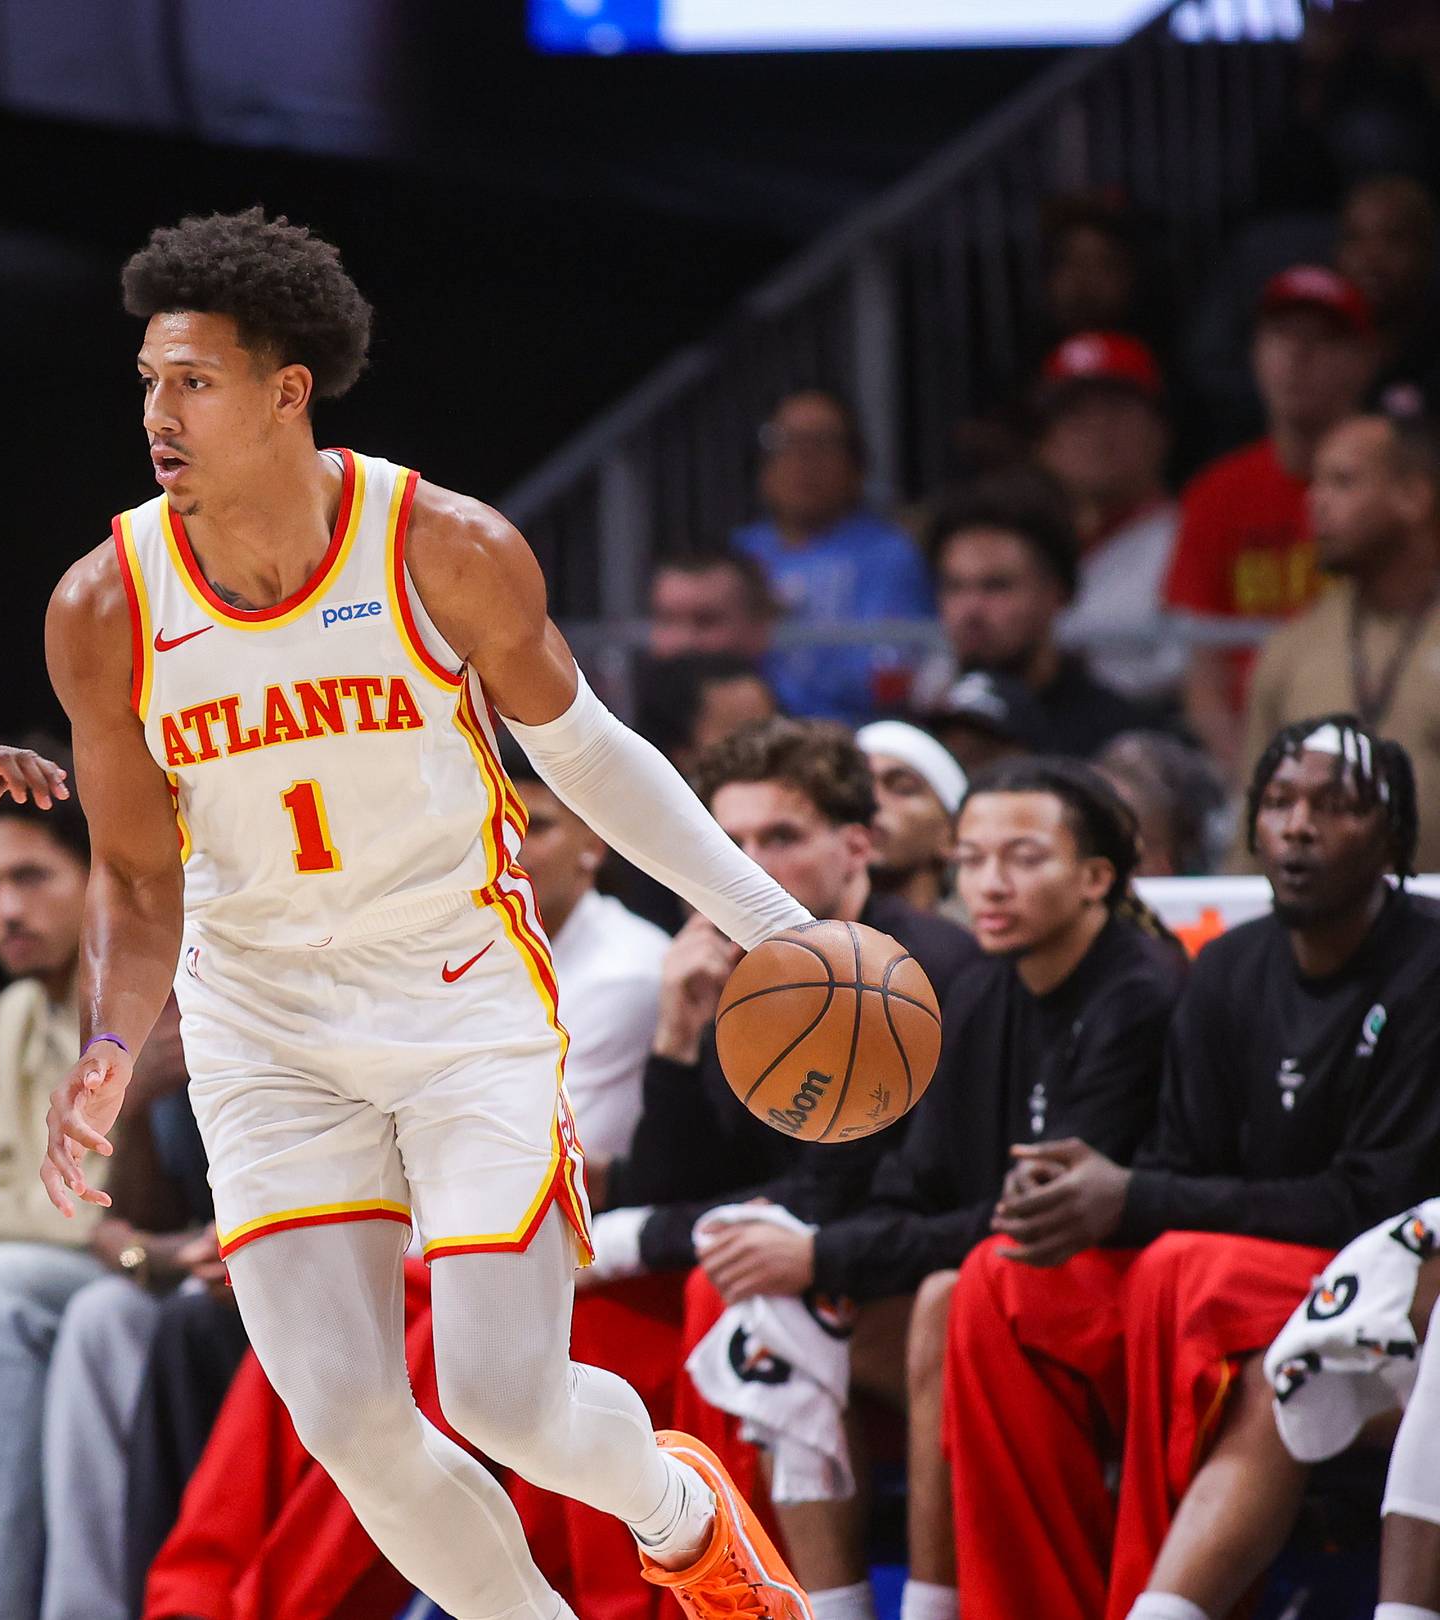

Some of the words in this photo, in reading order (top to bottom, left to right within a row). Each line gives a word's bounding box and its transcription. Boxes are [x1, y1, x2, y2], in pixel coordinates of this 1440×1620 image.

[321, 601, 382, 628] paze
[160, 676, 425, 767] ATLANTA
[279, 778, 343, 875] 1
[767, 1069, 833, 1135] ilson
